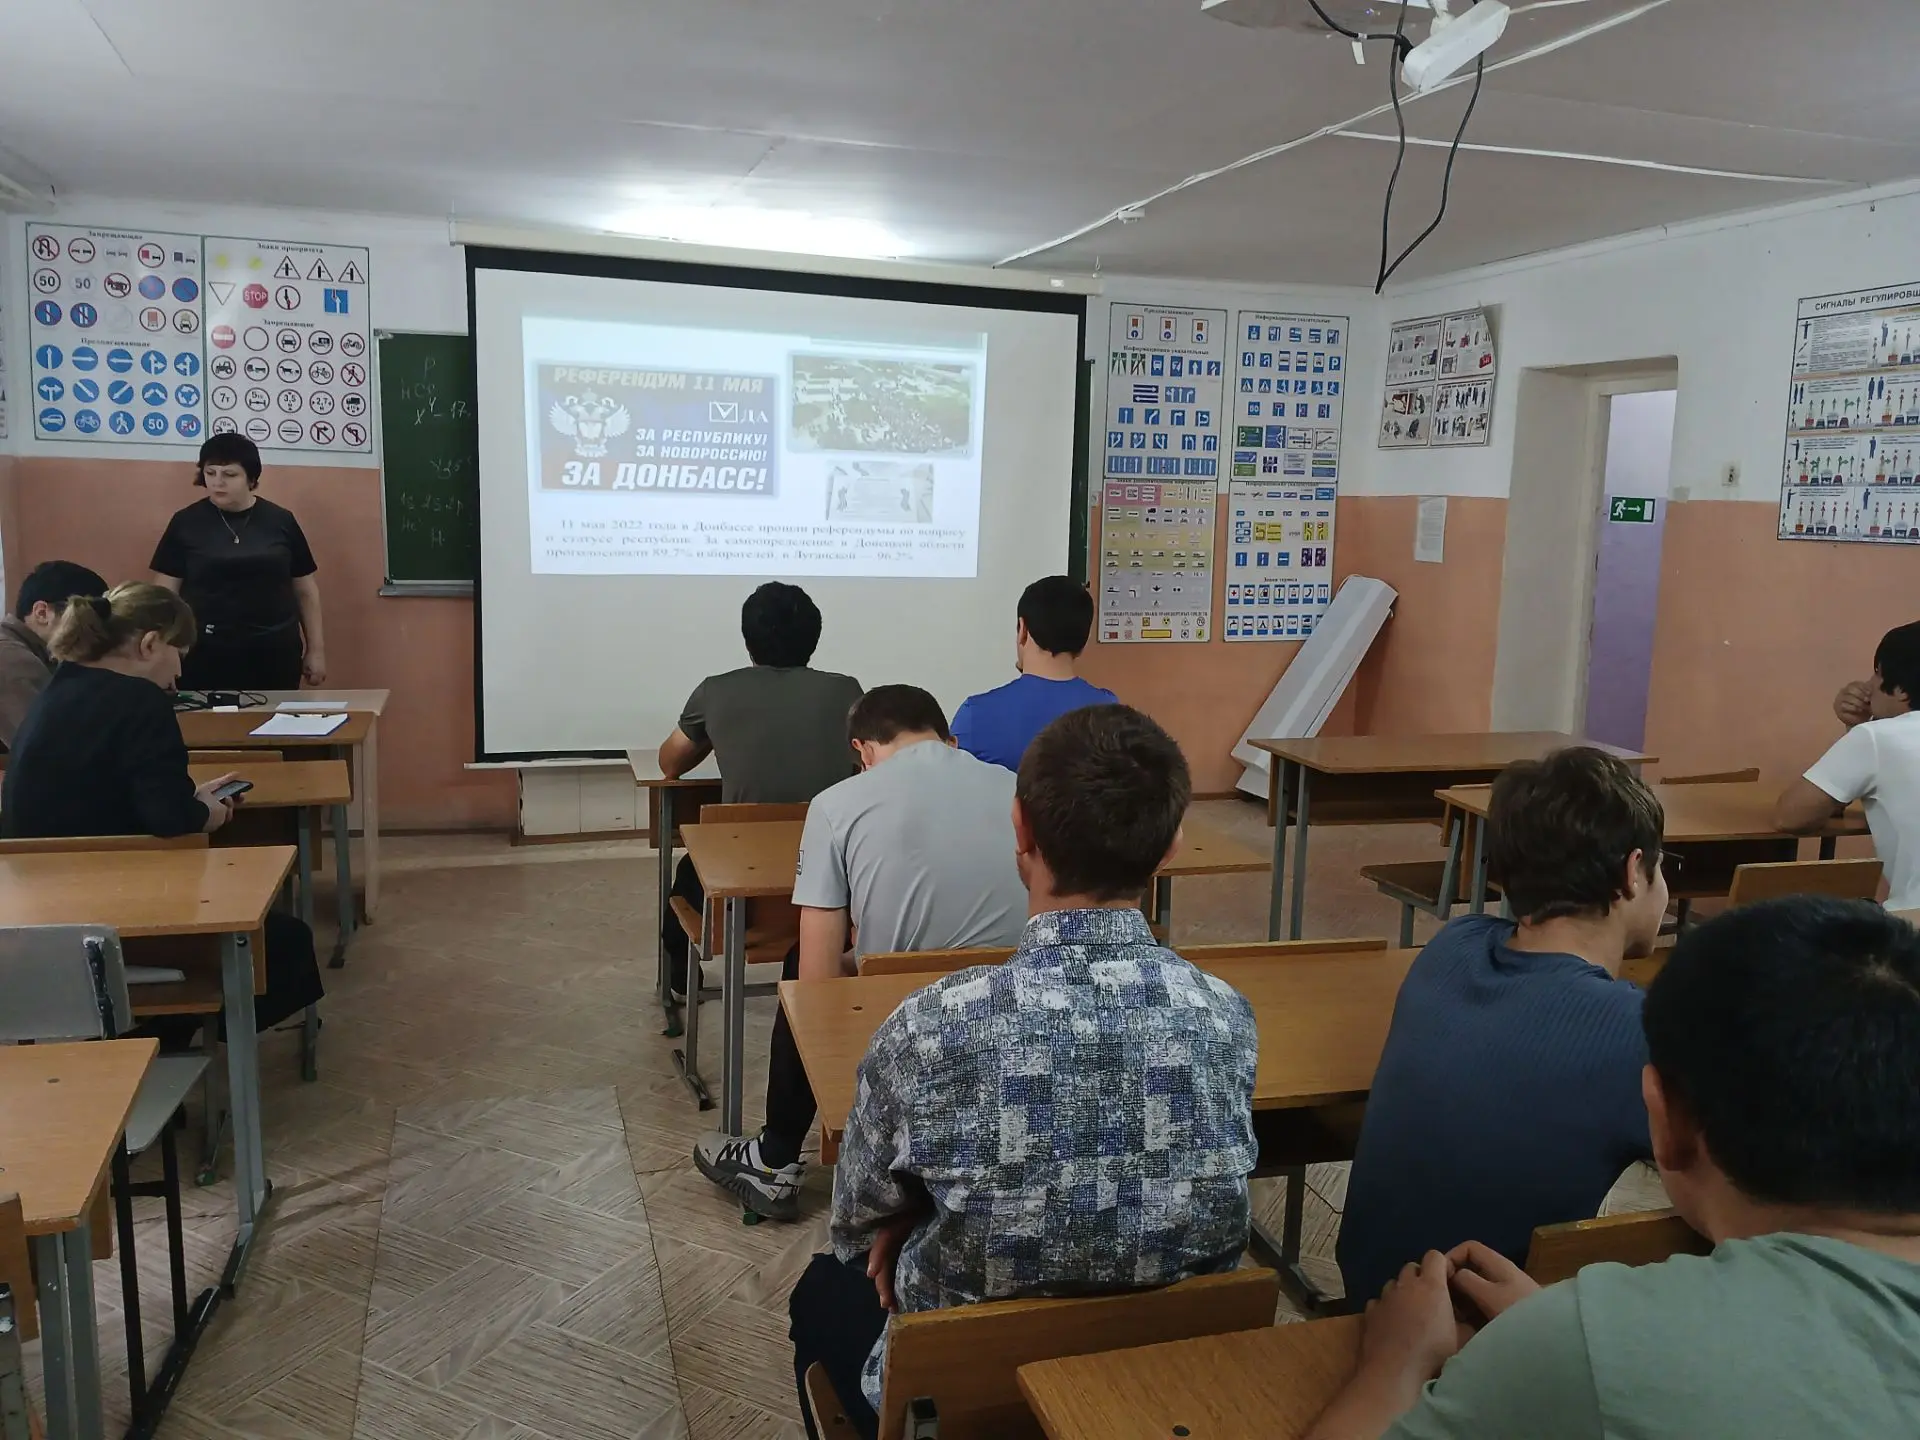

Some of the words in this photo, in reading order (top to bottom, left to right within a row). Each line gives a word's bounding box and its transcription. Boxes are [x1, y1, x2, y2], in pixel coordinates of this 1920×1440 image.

[39, 275, 55, 287] 50
[75, 277, 91, 290] 50
[244, 290, 267, 302] STOP
[1815, 298, 1856, 311] СИГНАЛЫ
[553, 367, 687, 390] РЕФЕРЕНДУМ
[693, 375, 715, 391] 11
[722, 376, 763, 394] МАЯ
[739, 407, 769, 425] ДА
[148, 419, 164, 430] 50
[636, 428, 655, 441] ЗА
[662, 429, 768, 446] РЕСПУБЛИКУ!
[636, 444, 655, 458] ЗА
[660, 446, 768, 462] НОВОРОССИЮ!
[561, 461, 601, 486] ЗА
[611, 462, 768, 491] ДОНБАСС!
[580, 521, 606, 531] мая
[648, 521, 678, 533] года
[692, 520, 755, 533] Донбассе
[758, 525, 808, 536] прошли
[812, 524, 896, 538] референдумы
[561, 535, 613, 545] статусе
[724, 536, 834, 548] самоопределение
[855, 538, 913, 550] Донецкой
[794, 550, 857, 562] Луганской
